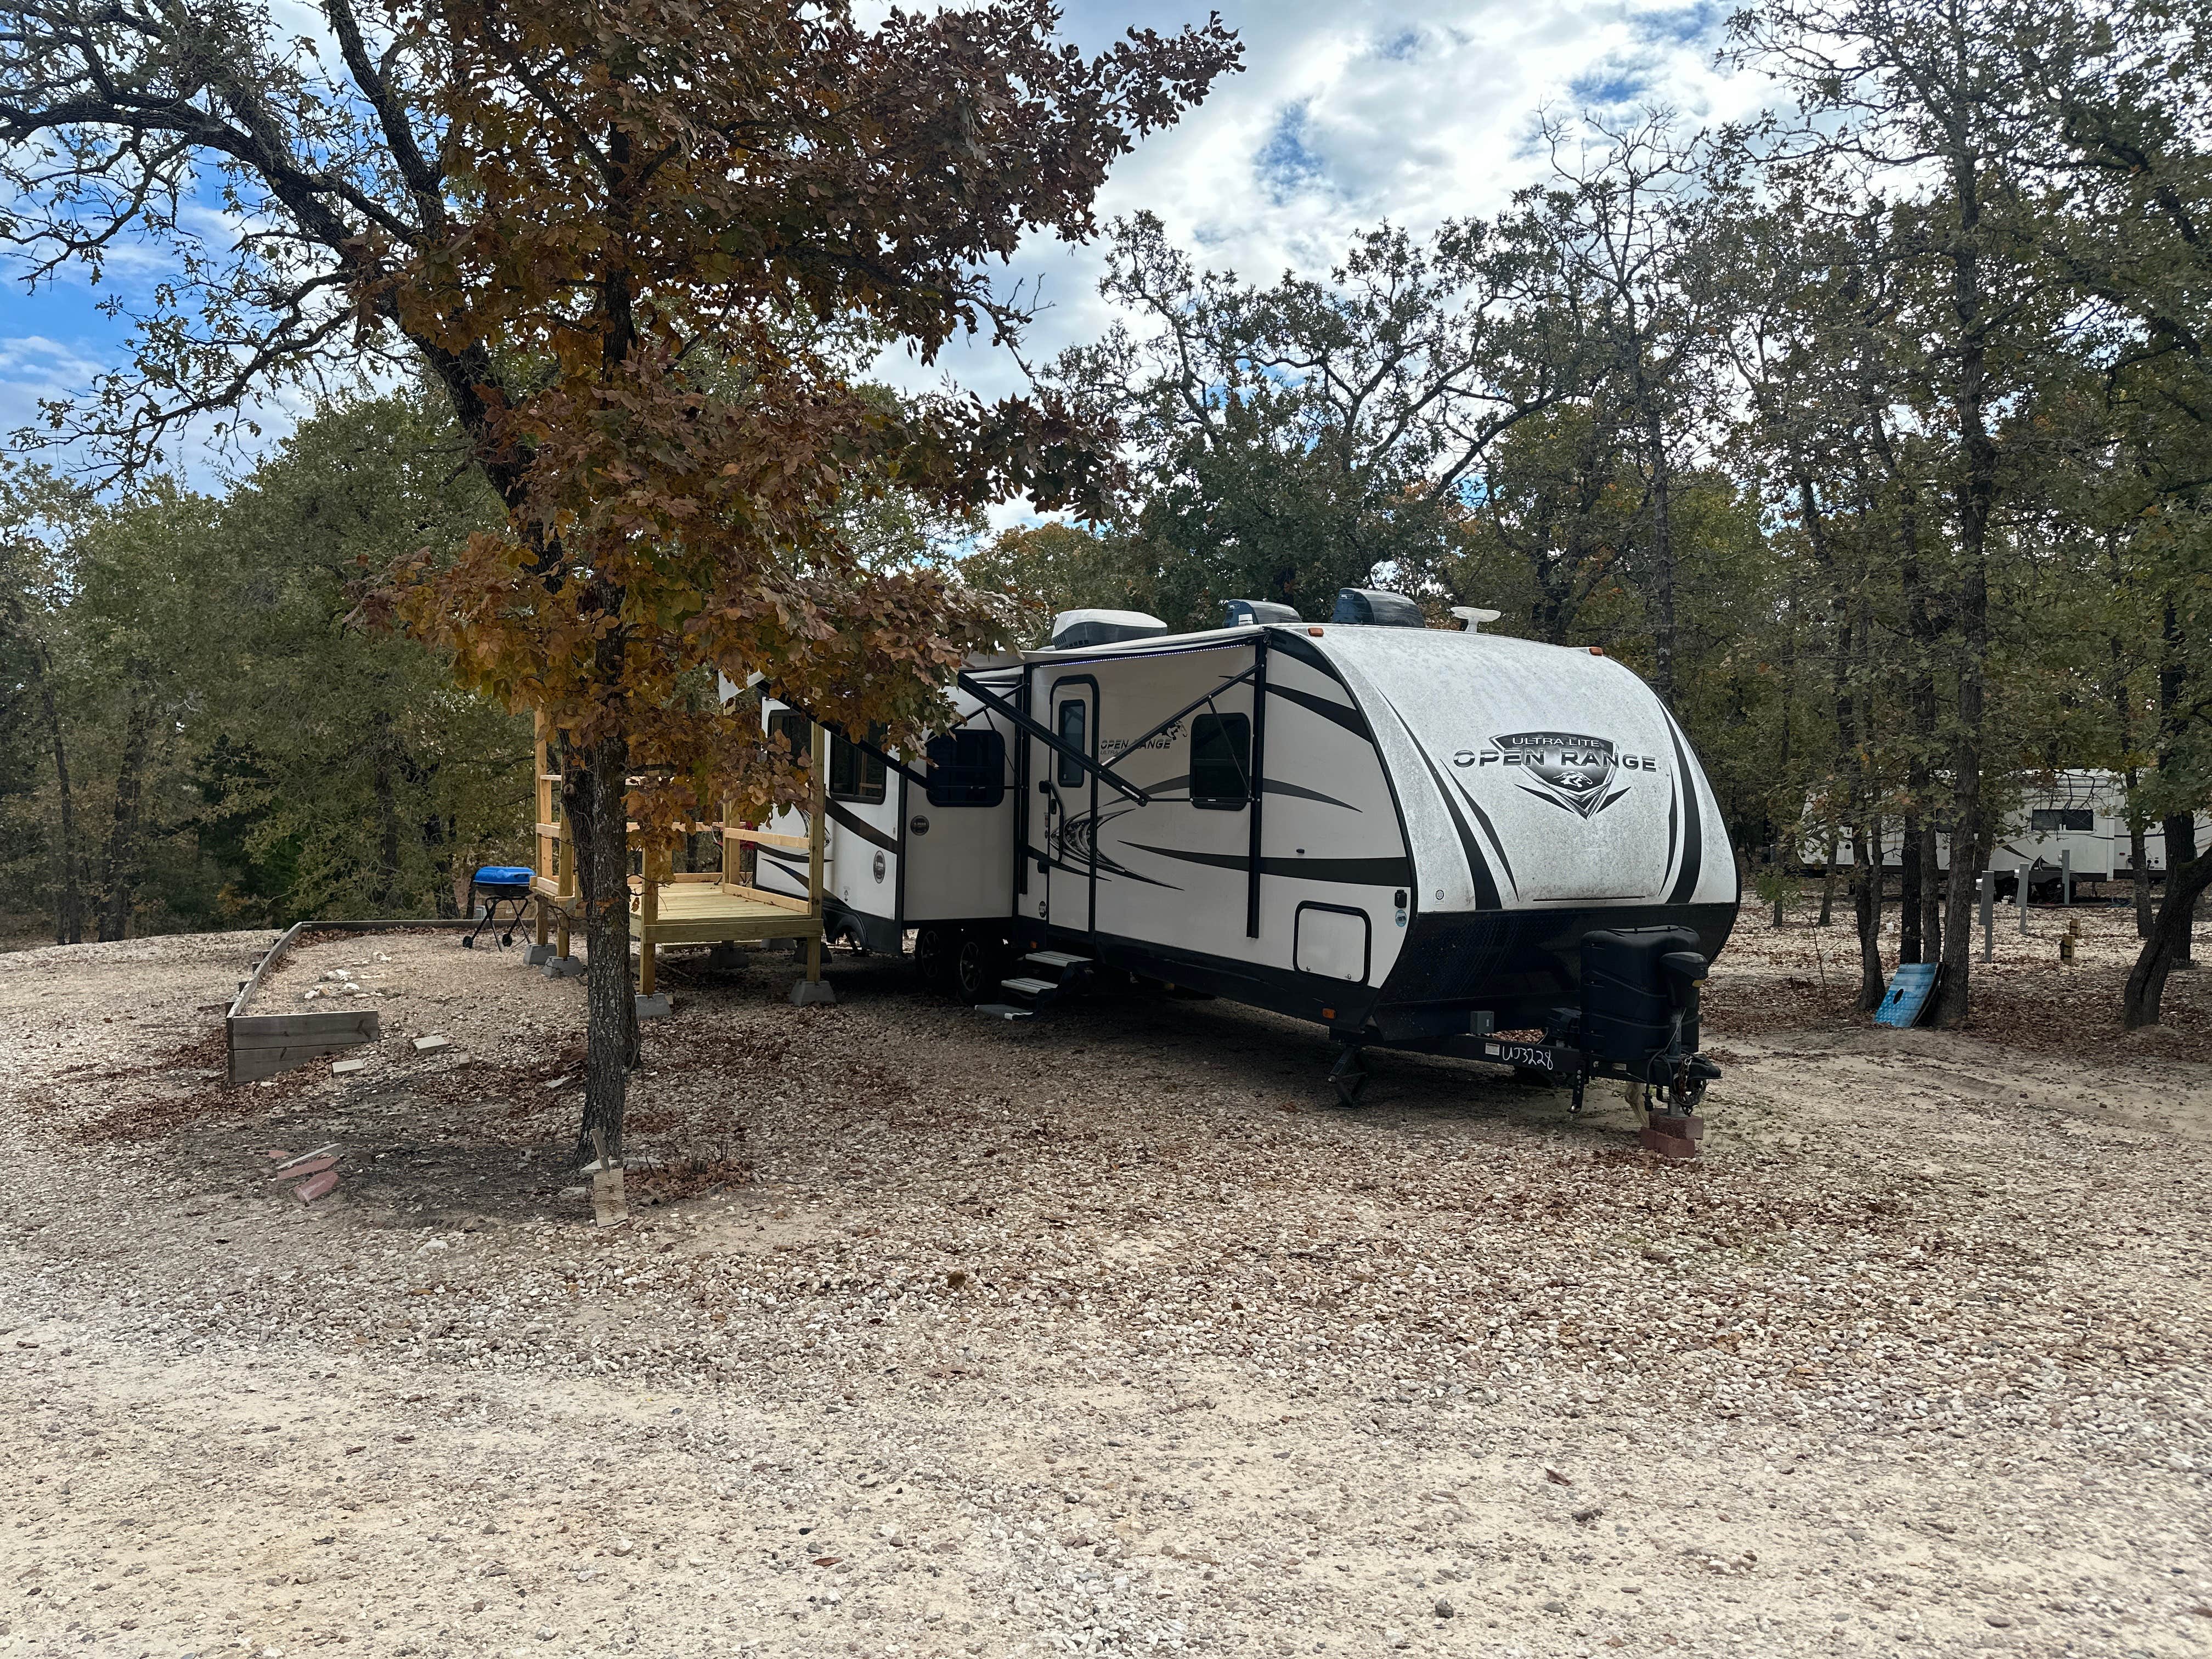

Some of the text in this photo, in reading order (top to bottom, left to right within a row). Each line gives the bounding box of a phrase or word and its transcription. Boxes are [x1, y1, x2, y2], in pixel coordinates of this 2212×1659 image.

[1101, 739, 1172, 749] OPEN ANGE
[1513, 737, 1600, 747] ULTRA LITE
[1453, 748, 1657, 772] OPEN RANGE
[1502, 1046, 1554, 1070] UJ3228
